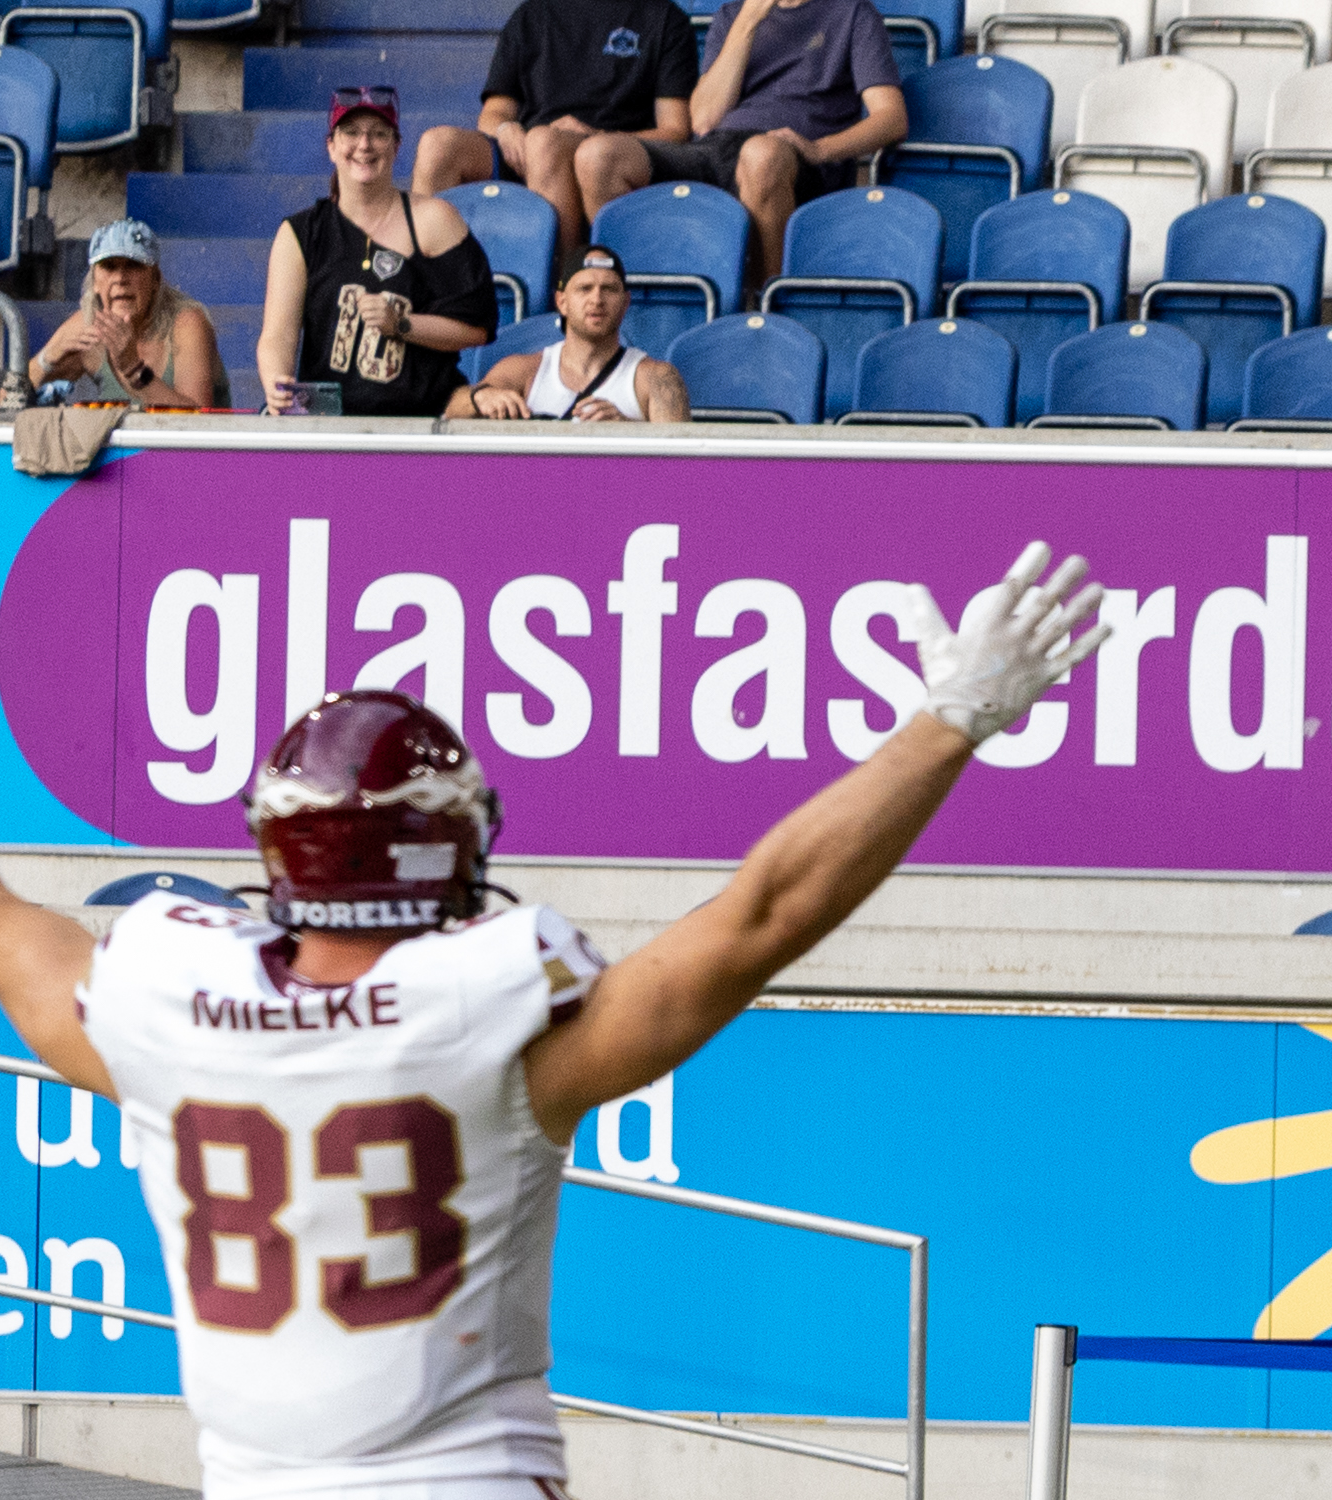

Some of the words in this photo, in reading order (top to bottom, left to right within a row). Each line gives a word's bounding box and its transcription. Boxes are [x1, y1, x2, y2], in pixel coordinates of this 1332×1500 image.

[288, 900, 442, 928] FORELLE
[193, 982, 401, 1031] MIELKE
[174, 1096, 467, 1335] 83
